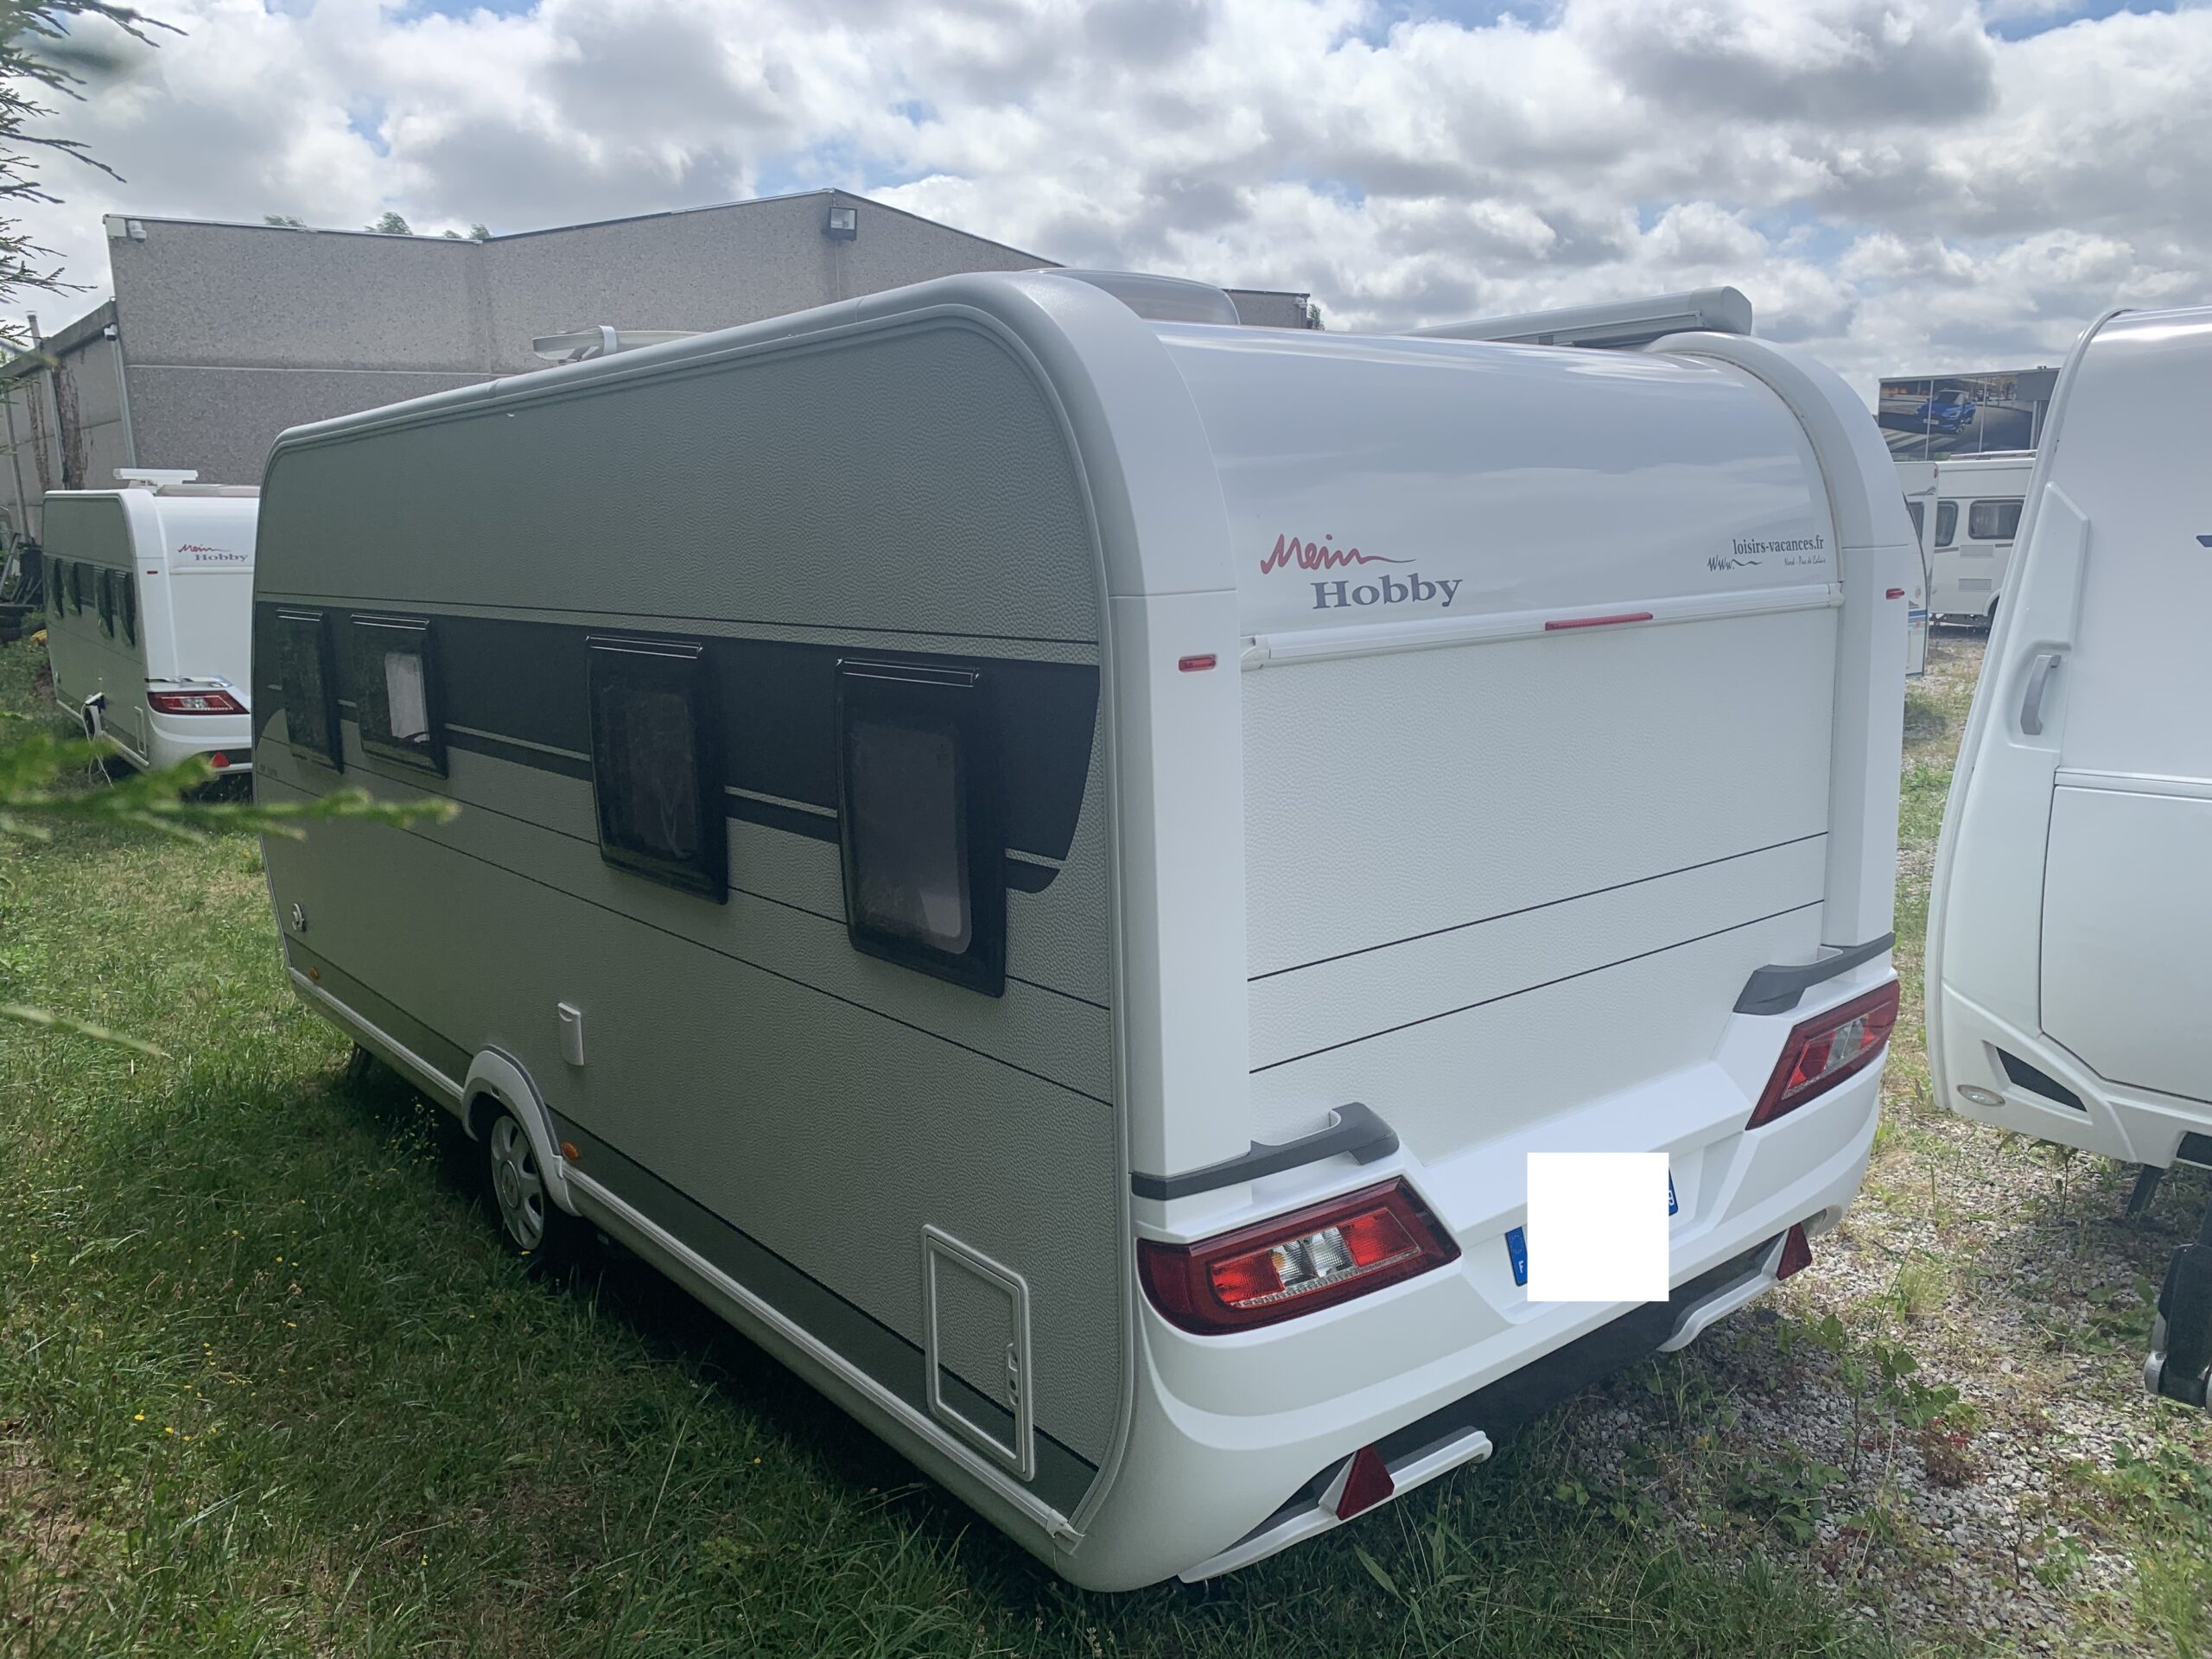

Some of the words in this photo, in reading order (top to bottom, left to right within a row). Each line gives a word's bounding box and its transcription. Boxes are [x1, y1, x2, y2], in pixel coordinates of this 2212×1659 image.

[178, 543, 230, 553] Mein
[1732, 535, 1824, 554] loisirs-vacances.fr
[195, 553, 249, 562] Hobby
[1261, 534, 1417, 574] Mein
[1310, 573, 1463, 609] Hobby
[1518, 1260, 1523, 1274] F
